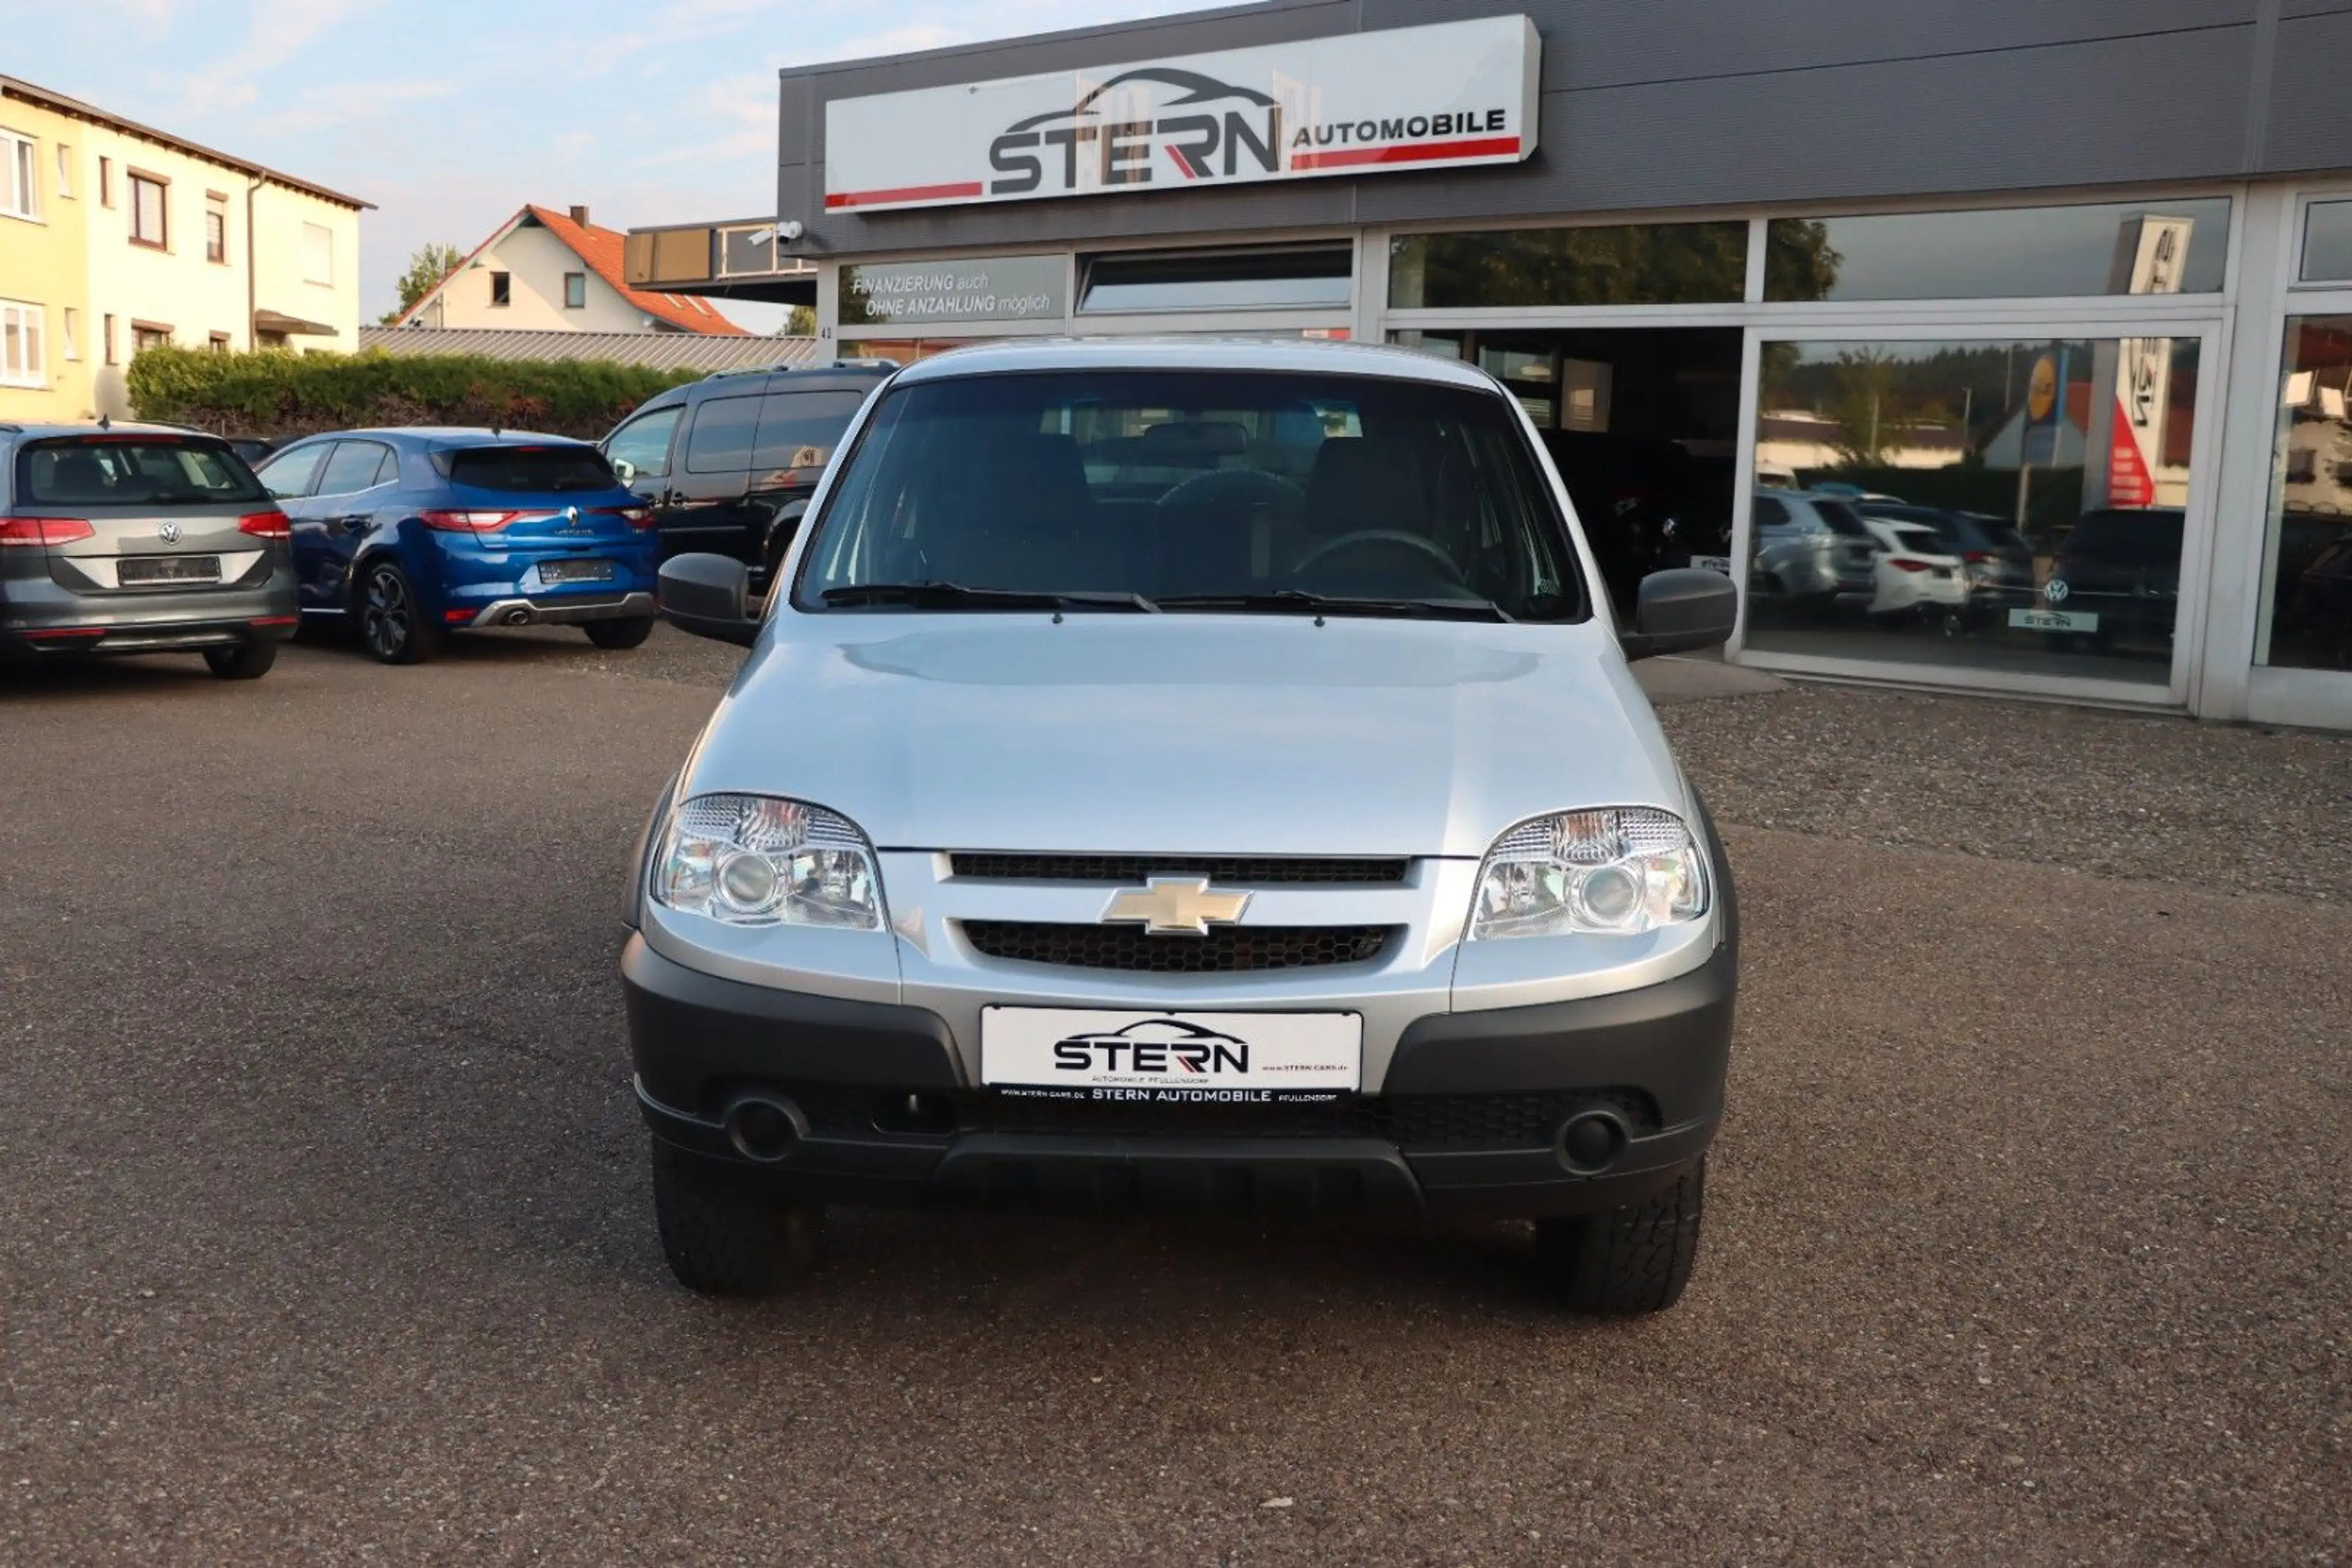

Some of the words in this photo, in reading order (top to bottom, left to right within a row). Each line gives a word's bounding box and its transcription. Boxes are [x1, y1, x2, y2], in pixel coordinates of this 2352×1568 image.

[989, 105, 1282, 195] STERN
[1292, 108, 1506, 148] AUTOMOBILE
[853, 274, 955, 295] FINANZIERUNG
[957, 273, 989, 291] auch
[865, 299, 903, 317] OHNE
[908, 295, 996, 315] ANZAHLUNG
[998, 293, 1050, 315] möglich
[1054, 1041, 1249, 1073] STERN
[1092, 1088, 1150, 1101] STERN
[1156, 1090, 1272, 1102] AUTOMOBILE
